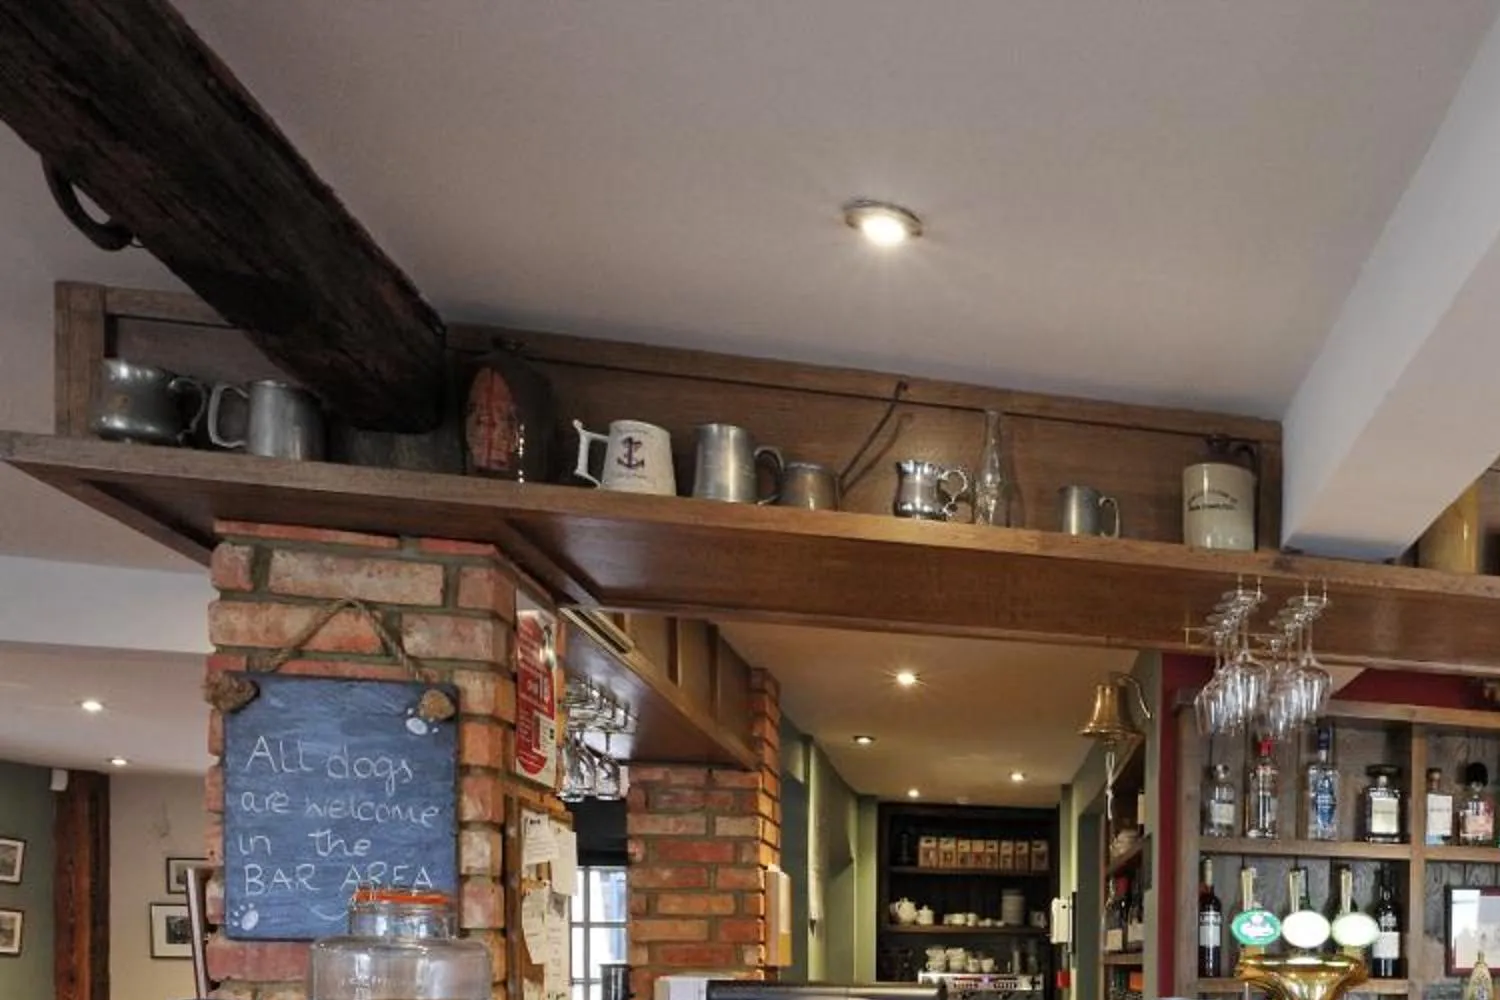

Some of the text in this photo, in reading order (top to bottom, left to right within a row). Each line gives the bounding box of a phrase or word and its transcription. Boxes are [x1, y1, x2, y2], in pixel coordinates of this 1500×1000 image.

[245, 735, 412, 797] All dogs
[241, 791, 439, 828] are welcome
[239, 829, 372, 857] in the
[244, 861, 433, 896] BAR AREA
